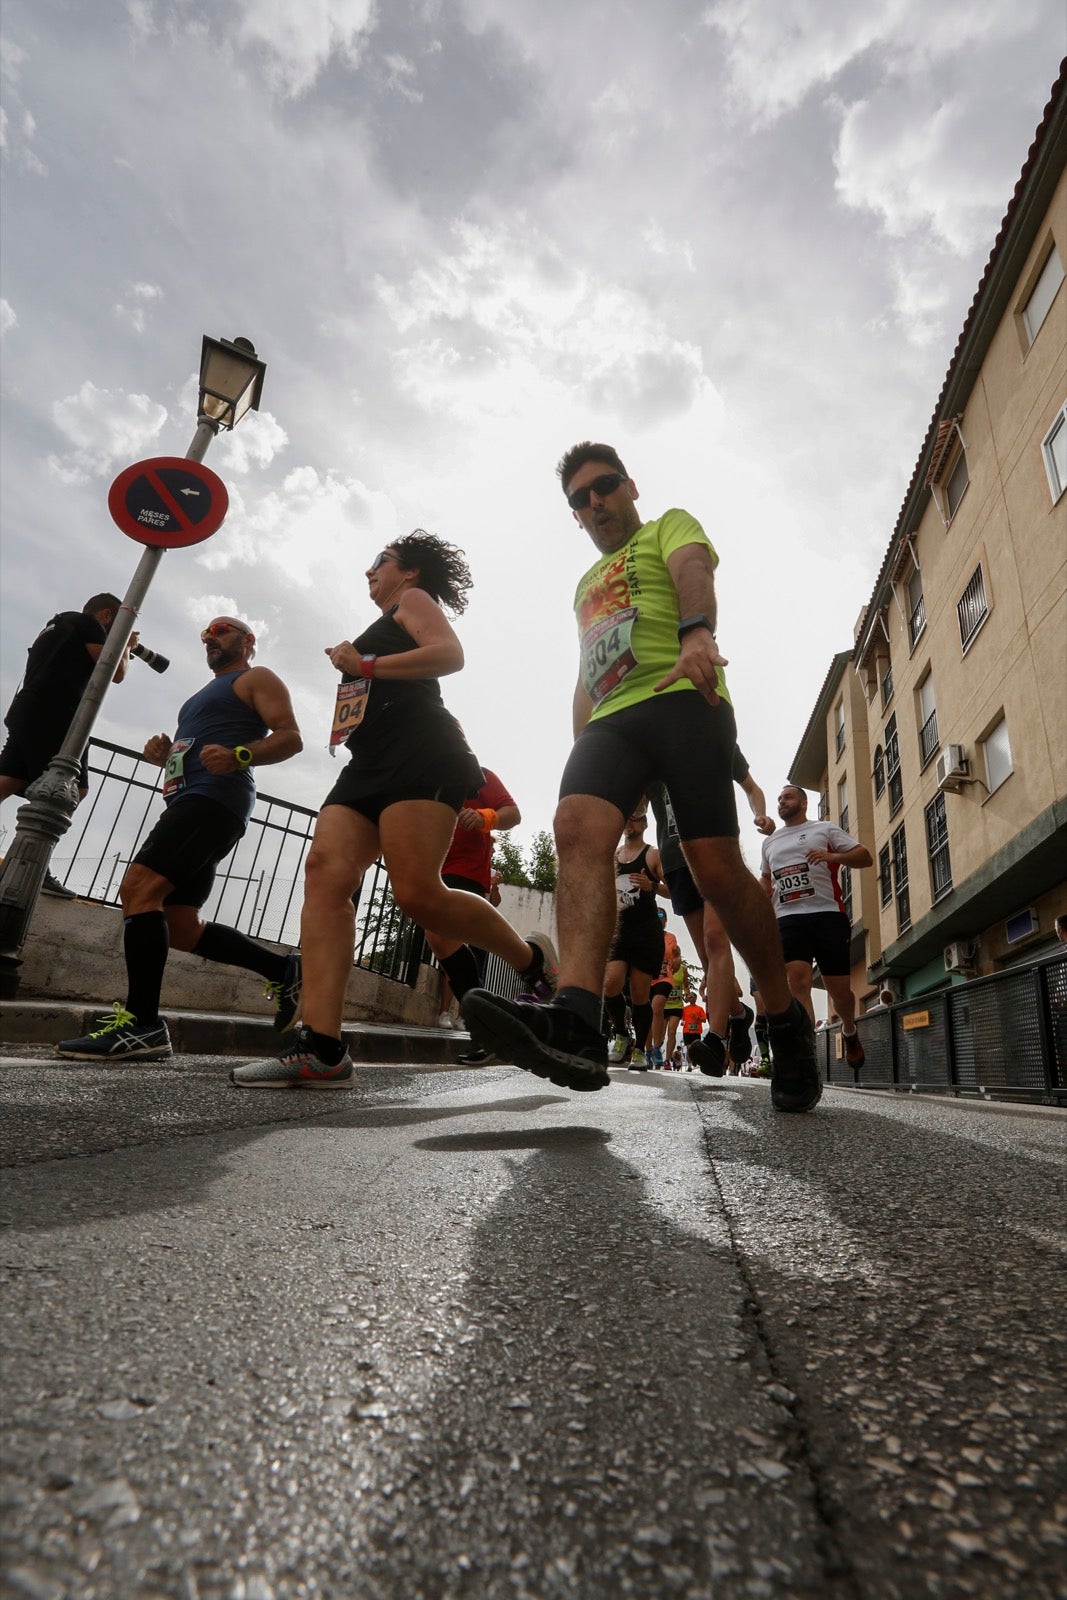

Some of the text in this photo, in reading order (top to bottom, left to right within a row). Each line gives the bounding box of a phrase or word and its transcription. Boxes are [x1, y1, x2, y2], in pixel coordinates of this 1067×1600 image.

[137, 515, 166, 527] PARES
[140, 508, 170, 521] MESES
[338, 699, 363, 723] 04
[779, 873, 810, 891] 3035
